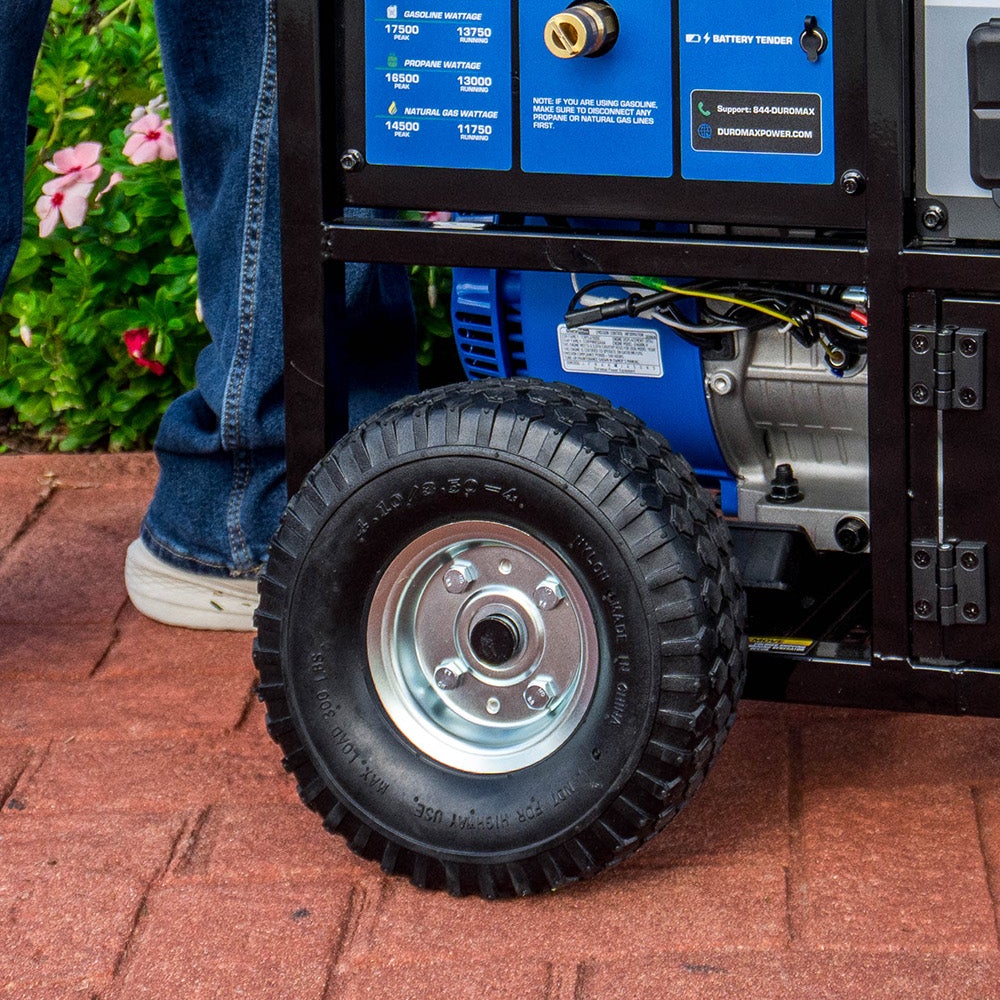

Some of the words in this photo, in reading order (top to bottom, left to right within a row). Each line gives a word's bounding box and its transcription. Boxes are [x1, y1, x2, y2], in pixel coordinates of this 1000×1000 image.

[403, 10, 443, 20] GASOLINE
[444, 12, 483, 21] WATTAGE
[384, 24, 420, 35] 17500
[456, 27, 492, 38] 13750
[712, 35, 754, 44] BATTERY
[755, 36, 793, 45] TENDER
[403, 59, 442, 69] PROPANE
[443, 61, 482, 70] WATTAGE
[384, 73, 420, 84] 16500
[456, 76, 492, 86] 13000
[563, 98, 579, 106] YOU
[595, 99, 619, 107] USING
[620, 100, 658, 109] GASOLINE,
[404, 107, 441, 116] NATURAL
[441, 109, 459, 118] GAS
[460, 110, 499, 119] WATTAGE
[532, 105, 555, 113] MAKE
[555, 106, 575, 114] SURE
[587, 107, 635, 116] DISCONNECT
[635, 109, 652, 117] ANY
[716, 104, 752, 114] Support:
[753, 106, 815, 116] 844-DUROMAX
[533, 113, 568, 121] PROPANE
[568, 114, 580, 122] OR
[580, 115, 616, 123] NATURAL
[616, 116, 632, 124] GAS
[632, 117, 655, 125] LINES
[384, 121, 420, 131] 14500
[457, 124, 492, 135] 11750
[533, 121, 555, 129] FIRST.
[717, 127, 813, 139] DUROMAXPOWER.COM
